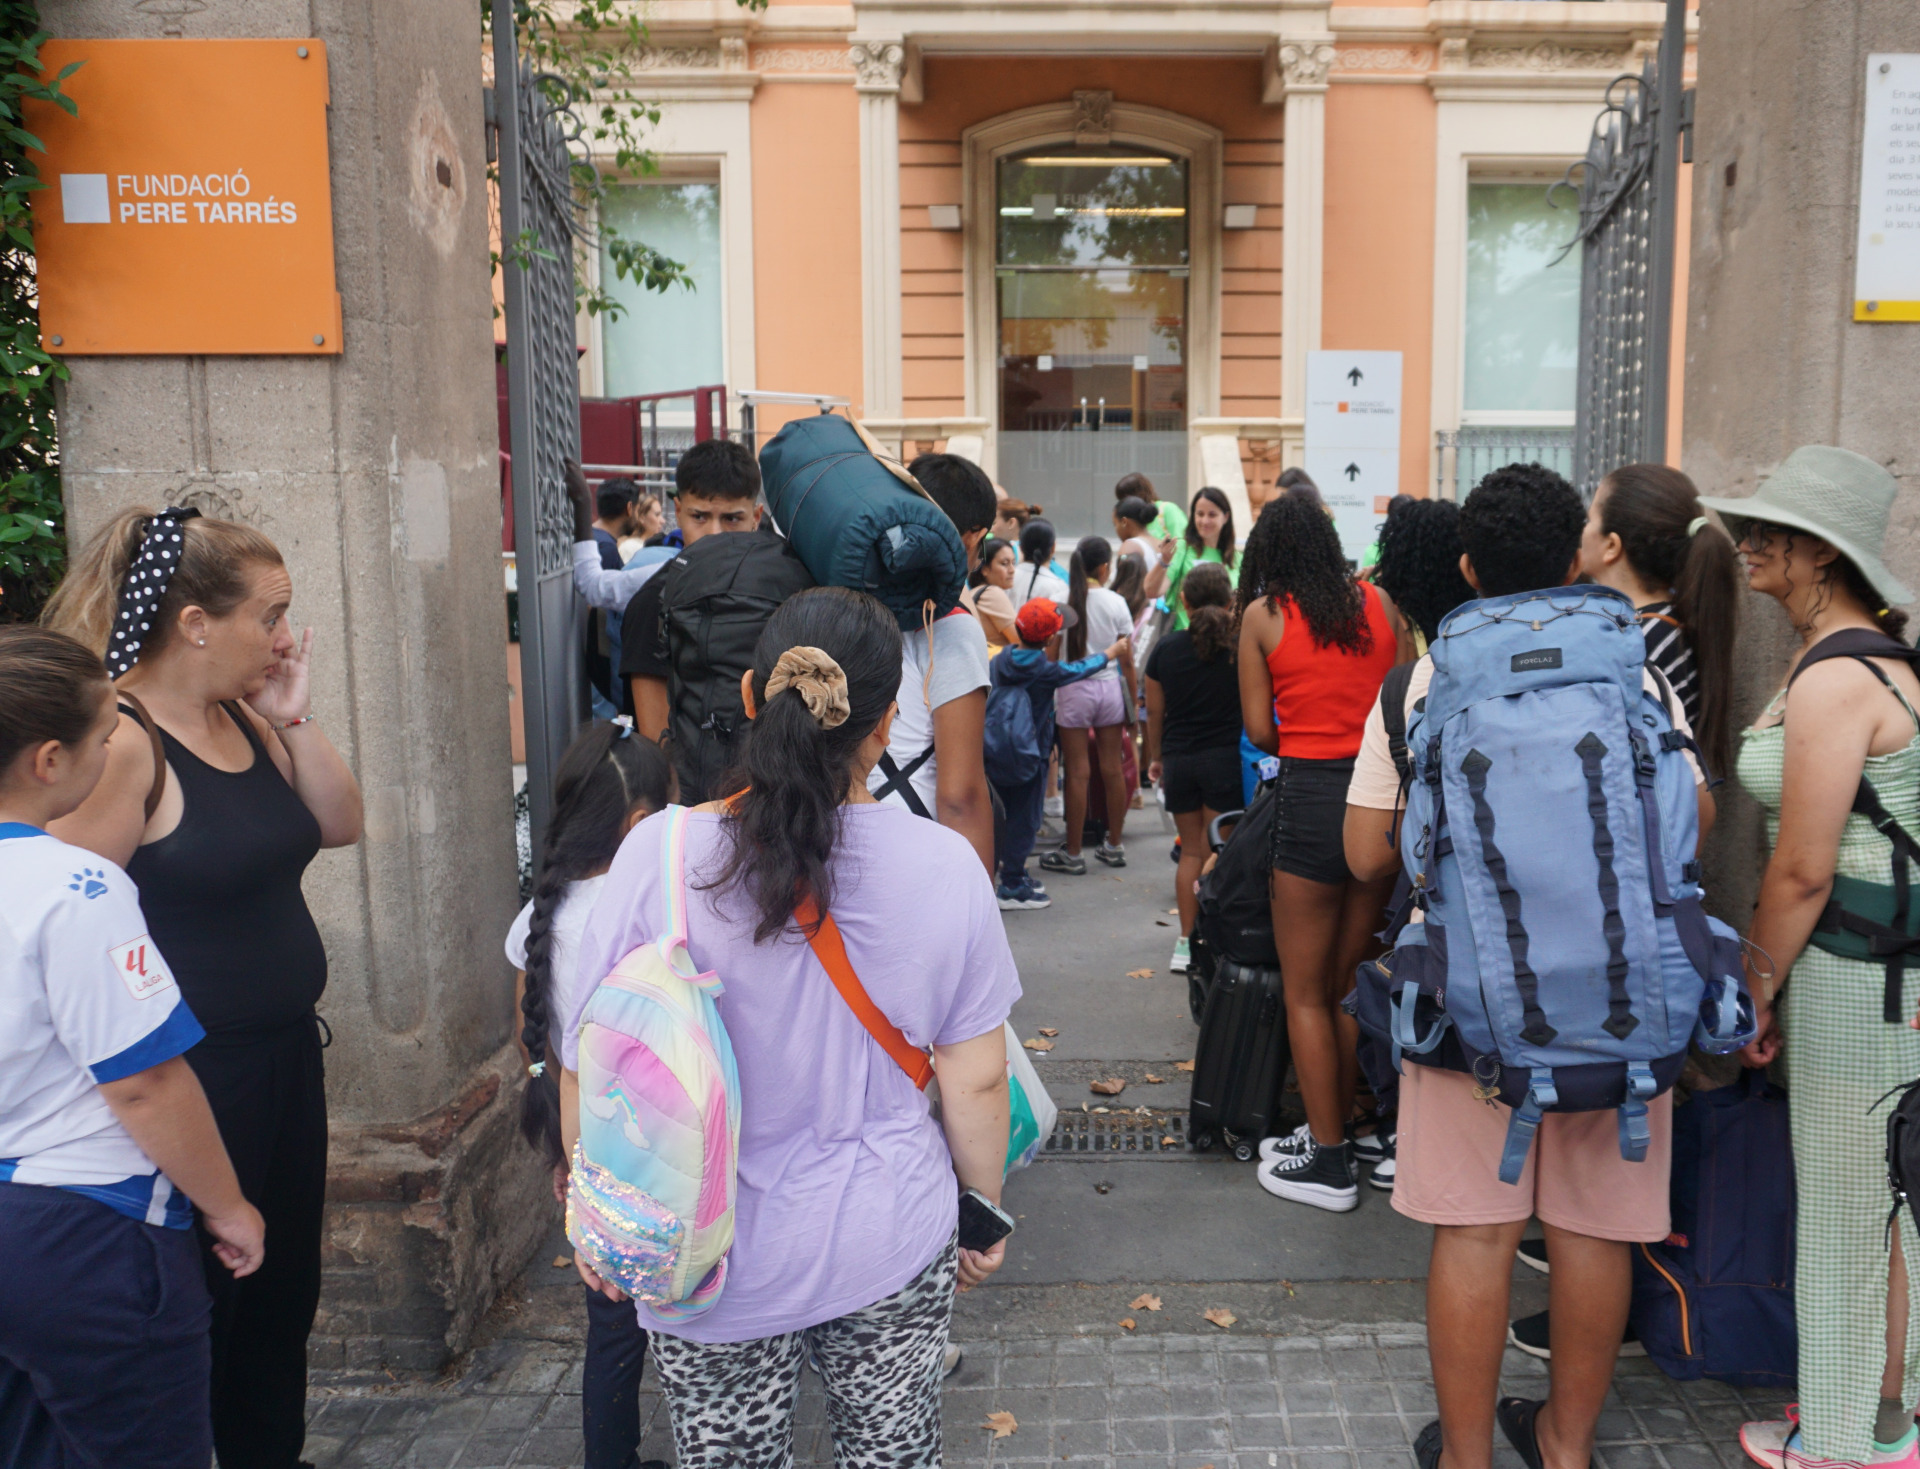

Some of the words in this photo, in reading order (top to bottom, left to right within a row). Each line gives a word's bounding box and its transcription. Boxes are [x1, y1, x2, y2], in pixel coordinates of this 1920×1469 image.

[1892, 89, 1906, 99] En
[1890, 122, 1903, 131] de
[118, 168, 250, 197] FUNDACIÓ
[119, 203, 188, 223] PERE
[193, 195, 298, 224] TARRÉS
[1520, 657, 1553, 665] FORCLAZ
[134, 973, 164, 992] LALIGA
